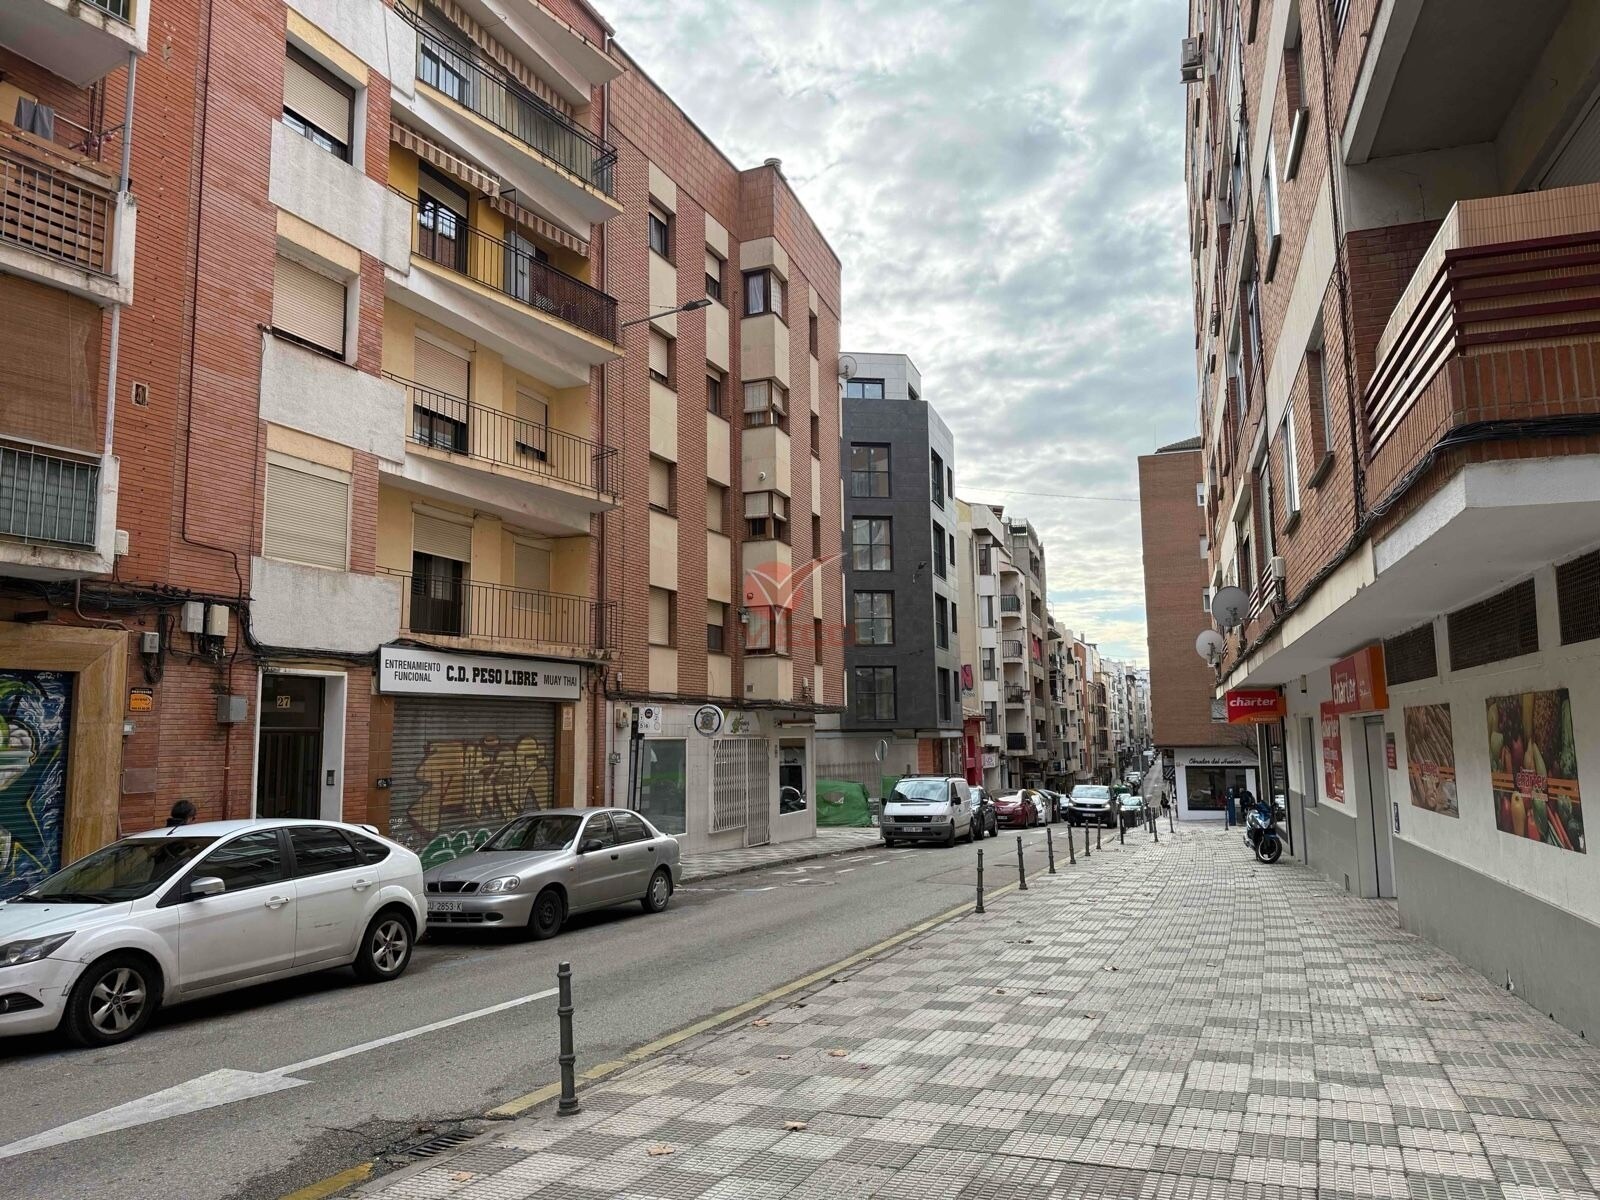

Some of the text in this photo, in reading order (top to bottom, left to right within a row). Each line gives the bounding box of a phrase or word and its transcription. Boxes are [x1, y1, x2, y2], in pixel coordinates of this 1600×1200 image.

[385, 659, 441, 672] ENTRENAMIENTO
[394, 671, 432, 682] FUNCIONAL
[446, 665, 538, 686] C.D. PESO LIBRE
[543, 674, 577, 687] MUAY THAI
[278, 697, 290, 707] 27
[1229, 697, 1276, 707] charter
[437, 902, 454, 911] 2853
